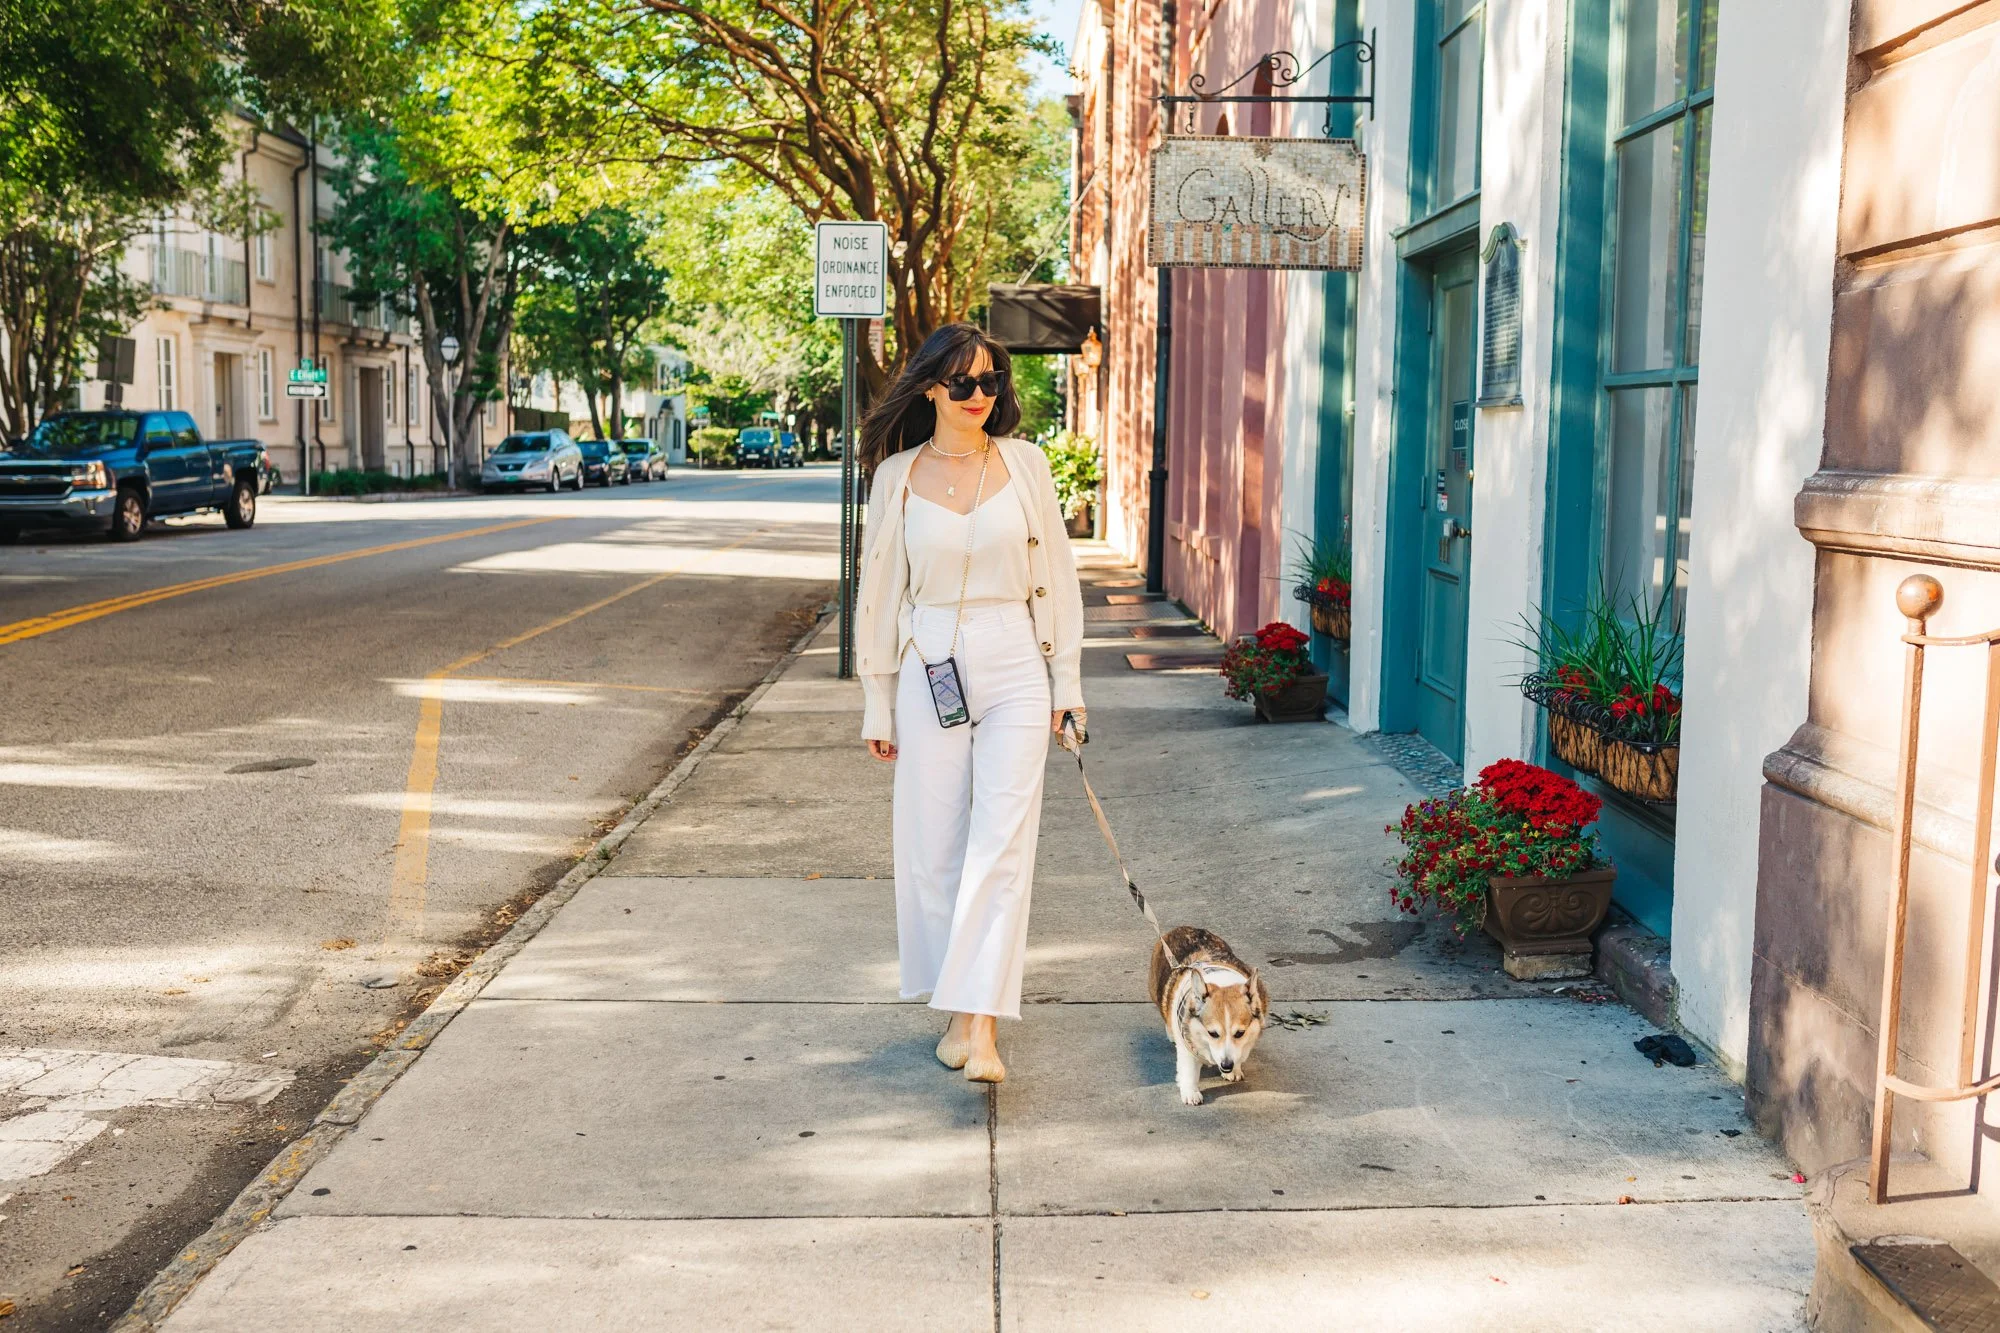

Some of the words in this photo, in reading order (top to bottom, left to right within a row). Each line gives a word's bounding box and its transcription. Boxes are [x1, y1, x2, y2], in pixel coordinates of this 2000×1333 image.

[833, 237, 868, 250] NOISE
[822, 261, 879, 274] ORDINANCE
[825, 285, 877, 298] ENFORCED
[1454, 418, 1469, 431] CLOSE
